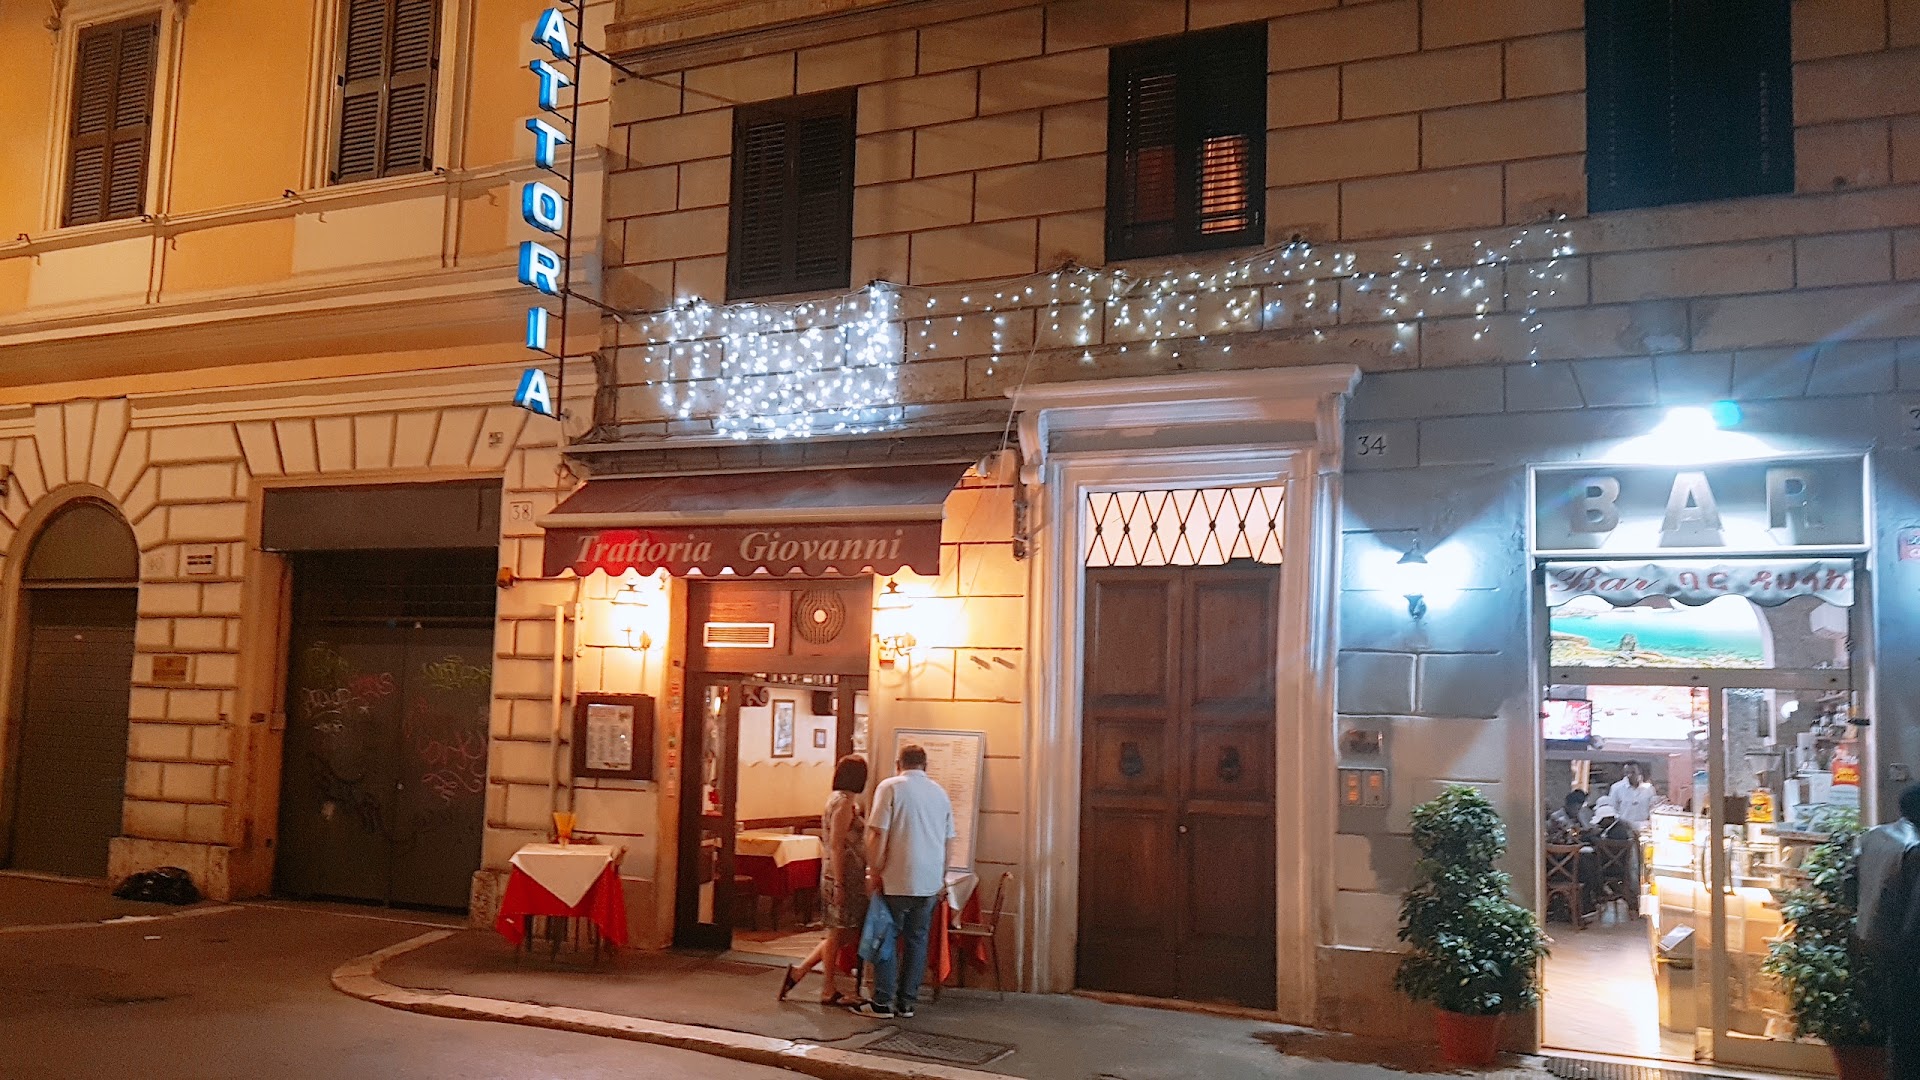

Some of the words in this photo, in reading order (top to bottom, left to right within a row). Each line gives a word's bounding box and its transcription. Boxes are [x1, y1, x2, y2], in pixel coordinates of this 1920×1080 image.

[1357, 435, 1387, 456] 34
[512, 504, 530, 520] 38
[1570, 469, 1824, 534] BAR
[575, 533, 711, 564] Trattoria
[739, 529, 903, 563] Giovanni
[1550, 565, 1661, 592] Bar
